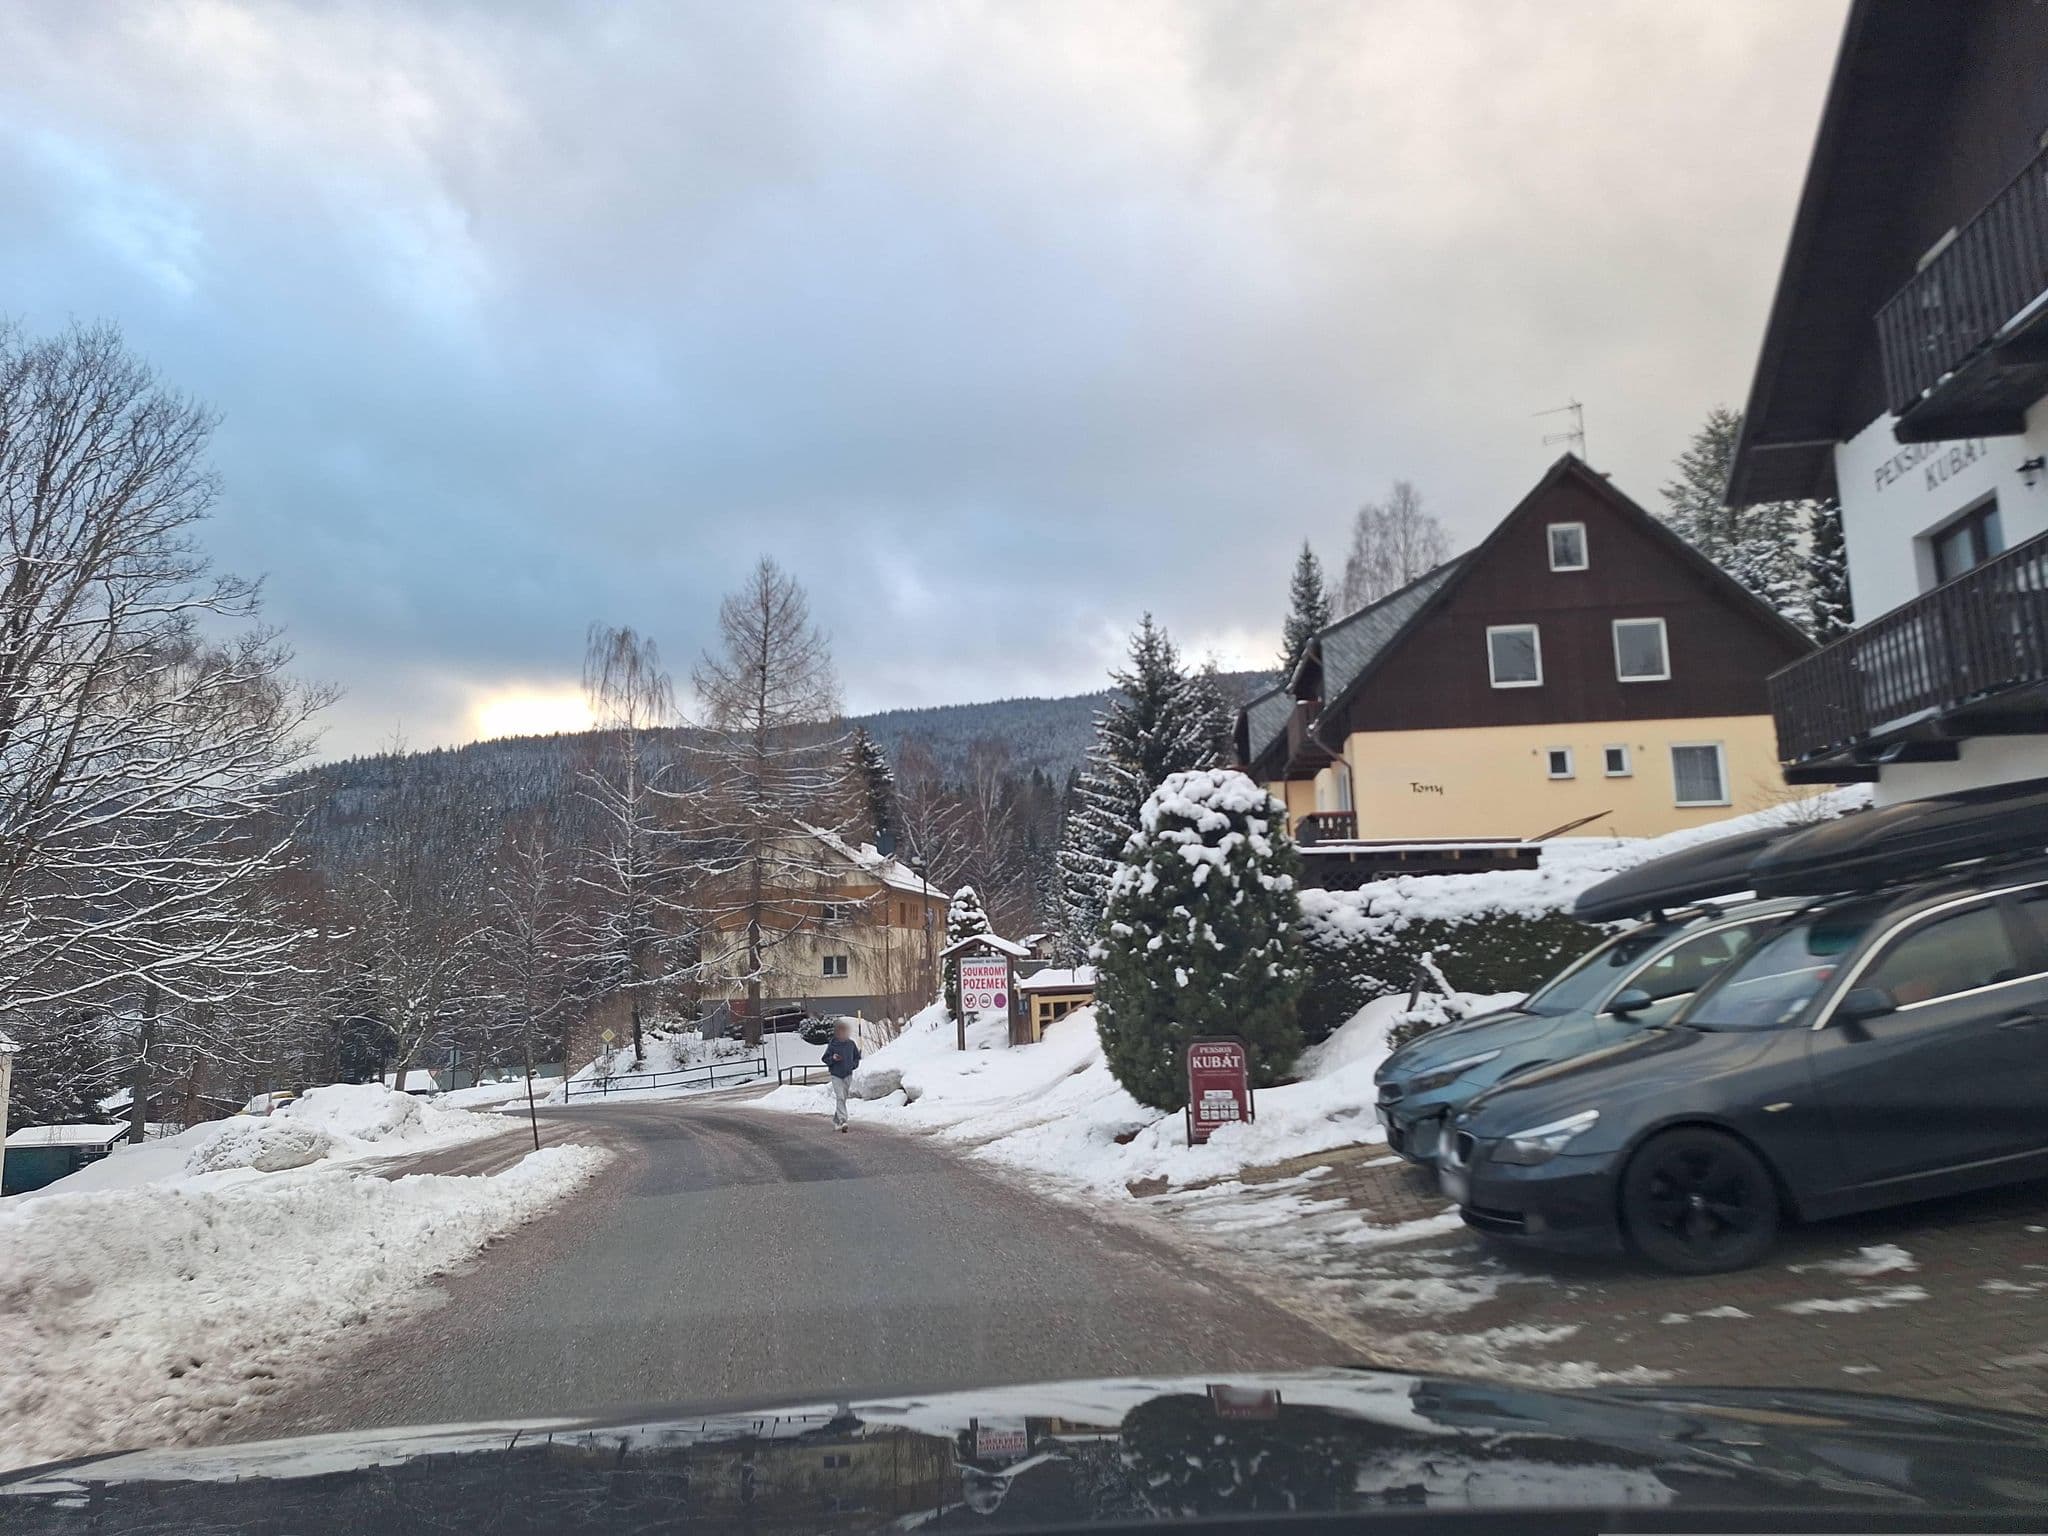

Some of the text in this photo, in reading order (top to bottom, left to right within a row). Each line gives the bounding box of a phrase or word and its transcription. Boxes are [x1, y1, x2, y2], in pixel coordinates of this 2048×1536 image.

[1409, 782, 1443, 795] Tony
[962, 978, 1007, 989] POZEMEK
[1192, 1053, 1241, 1068] KUBÁT
